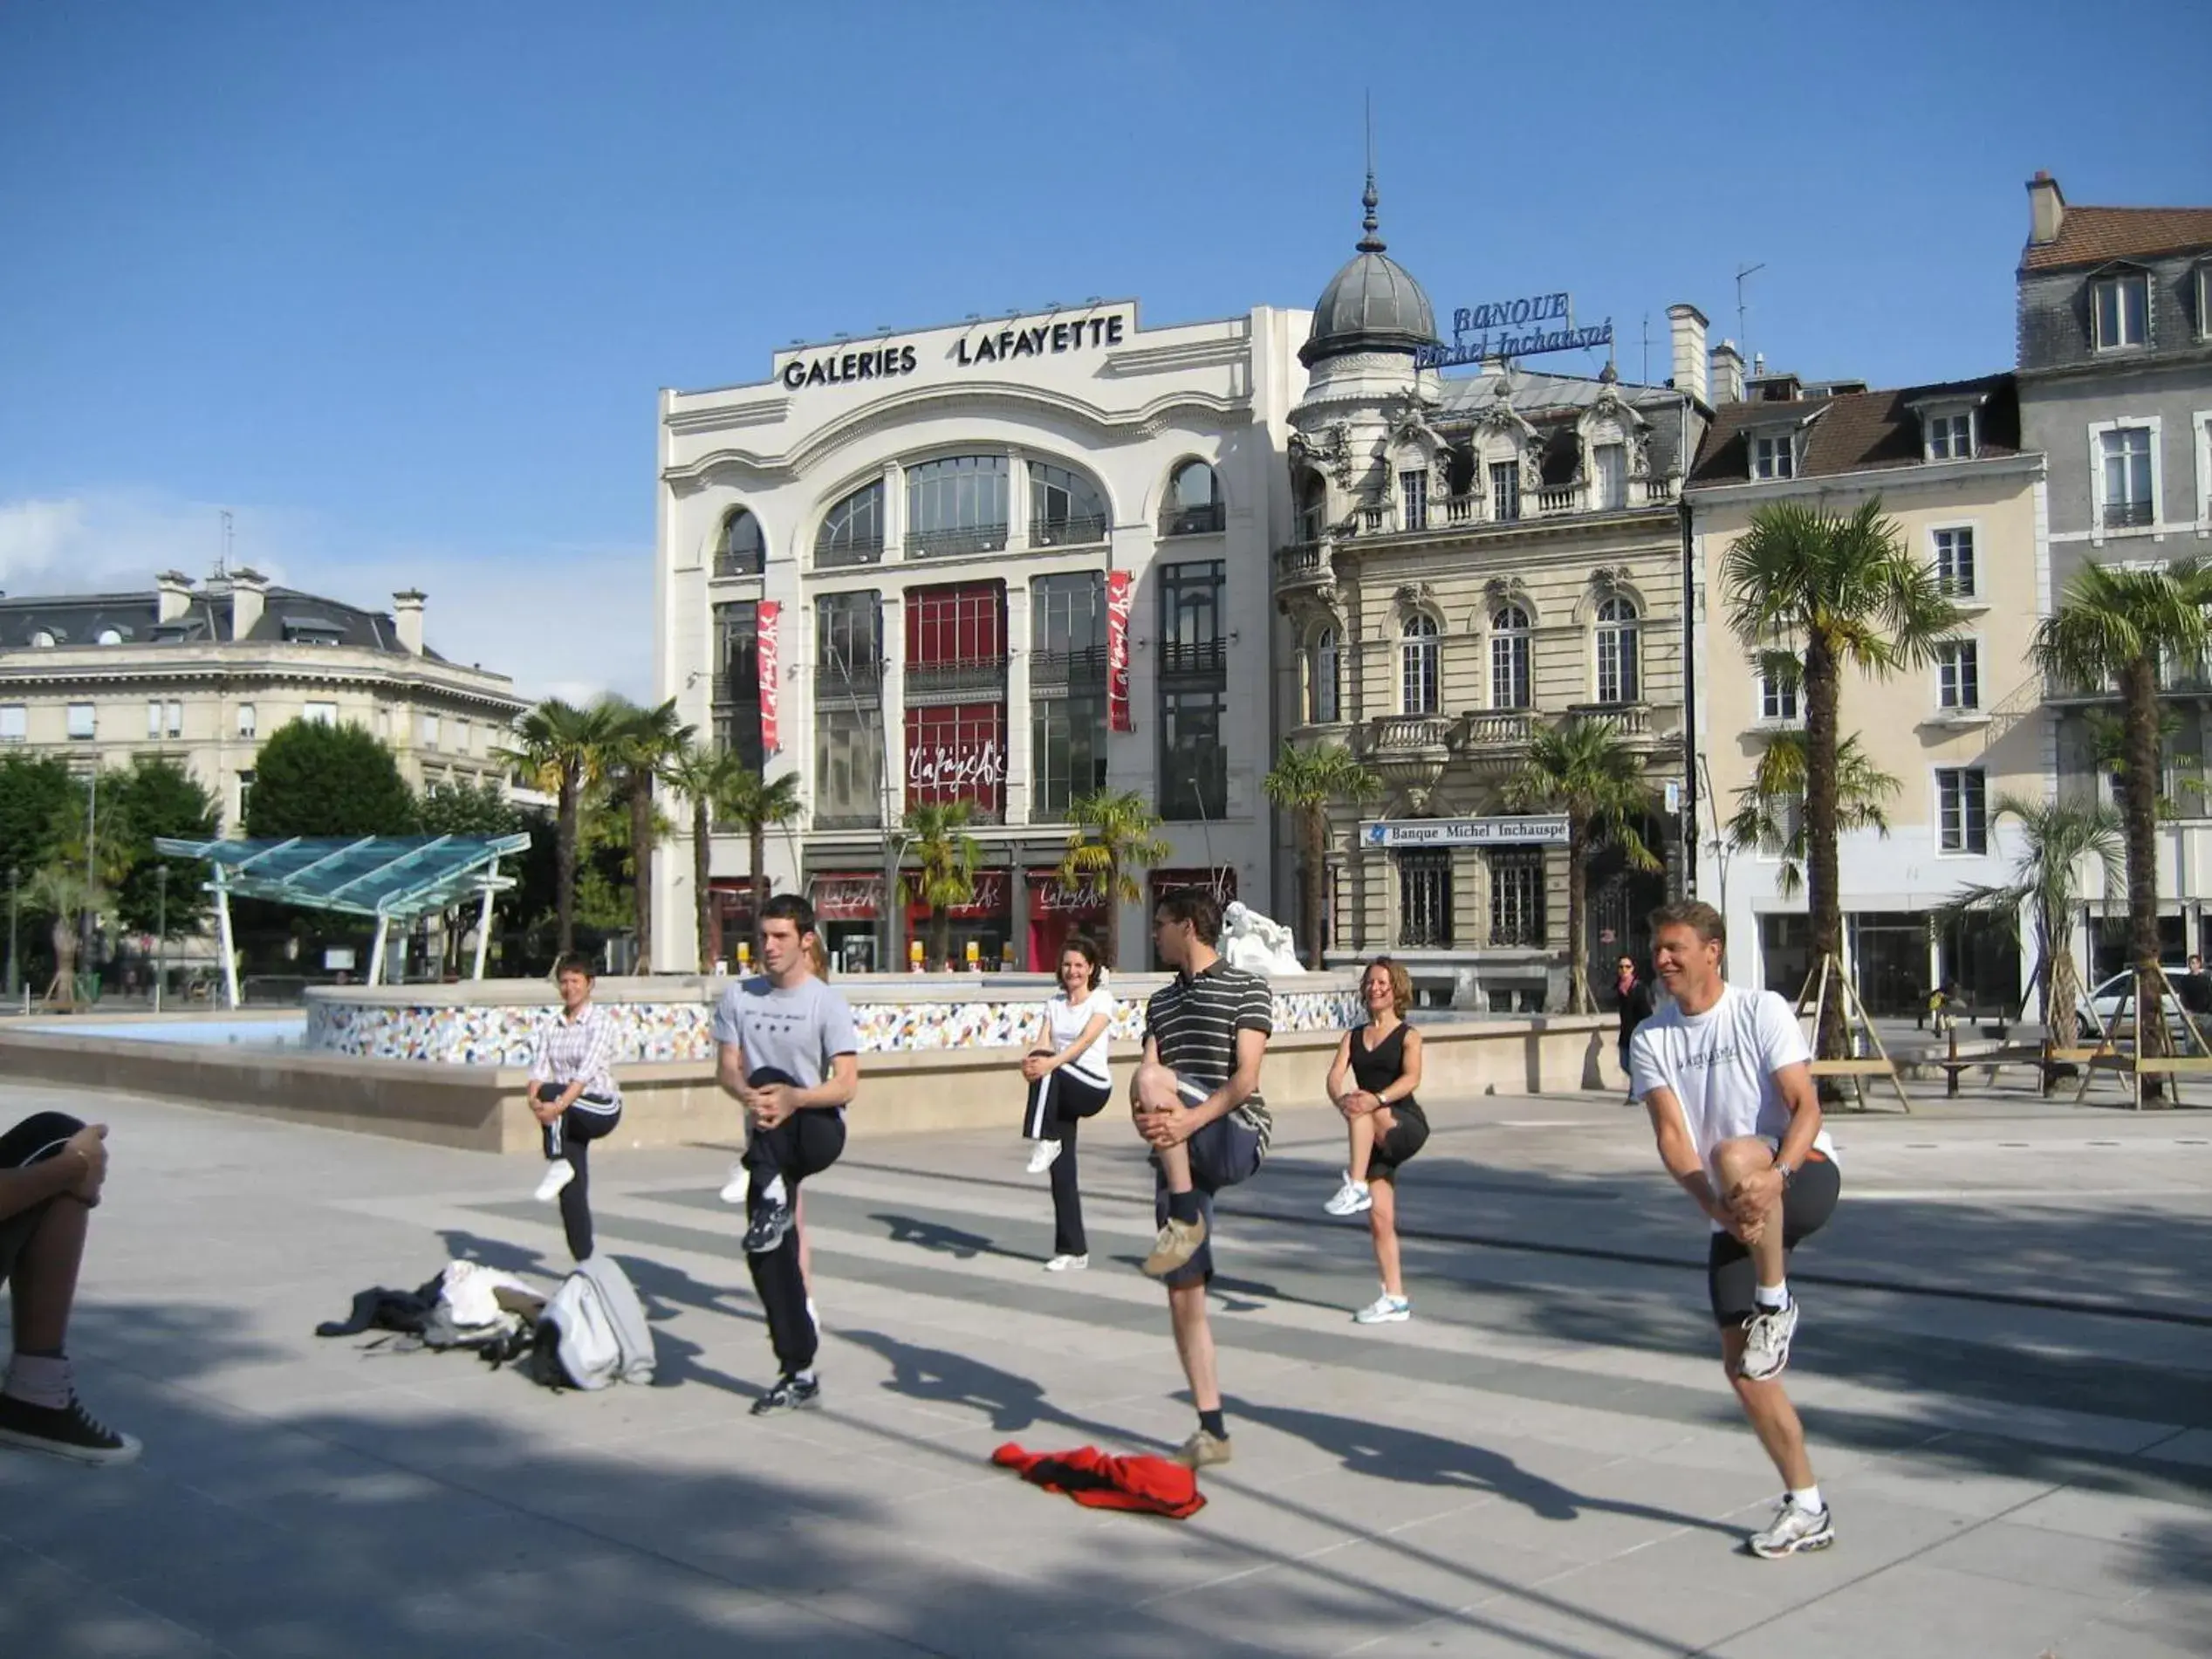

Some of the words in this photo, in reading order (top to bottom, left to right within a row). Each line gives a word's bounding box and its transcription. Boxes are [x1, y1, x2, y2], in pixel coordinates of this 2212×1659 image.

[784, 346, 916, 388] GALERIES
[957, 314, 1123, 366] LAFAYETTE
[1393, 826, 1439, 840] Banque
[1447, 825, 1490, 838] Michel
